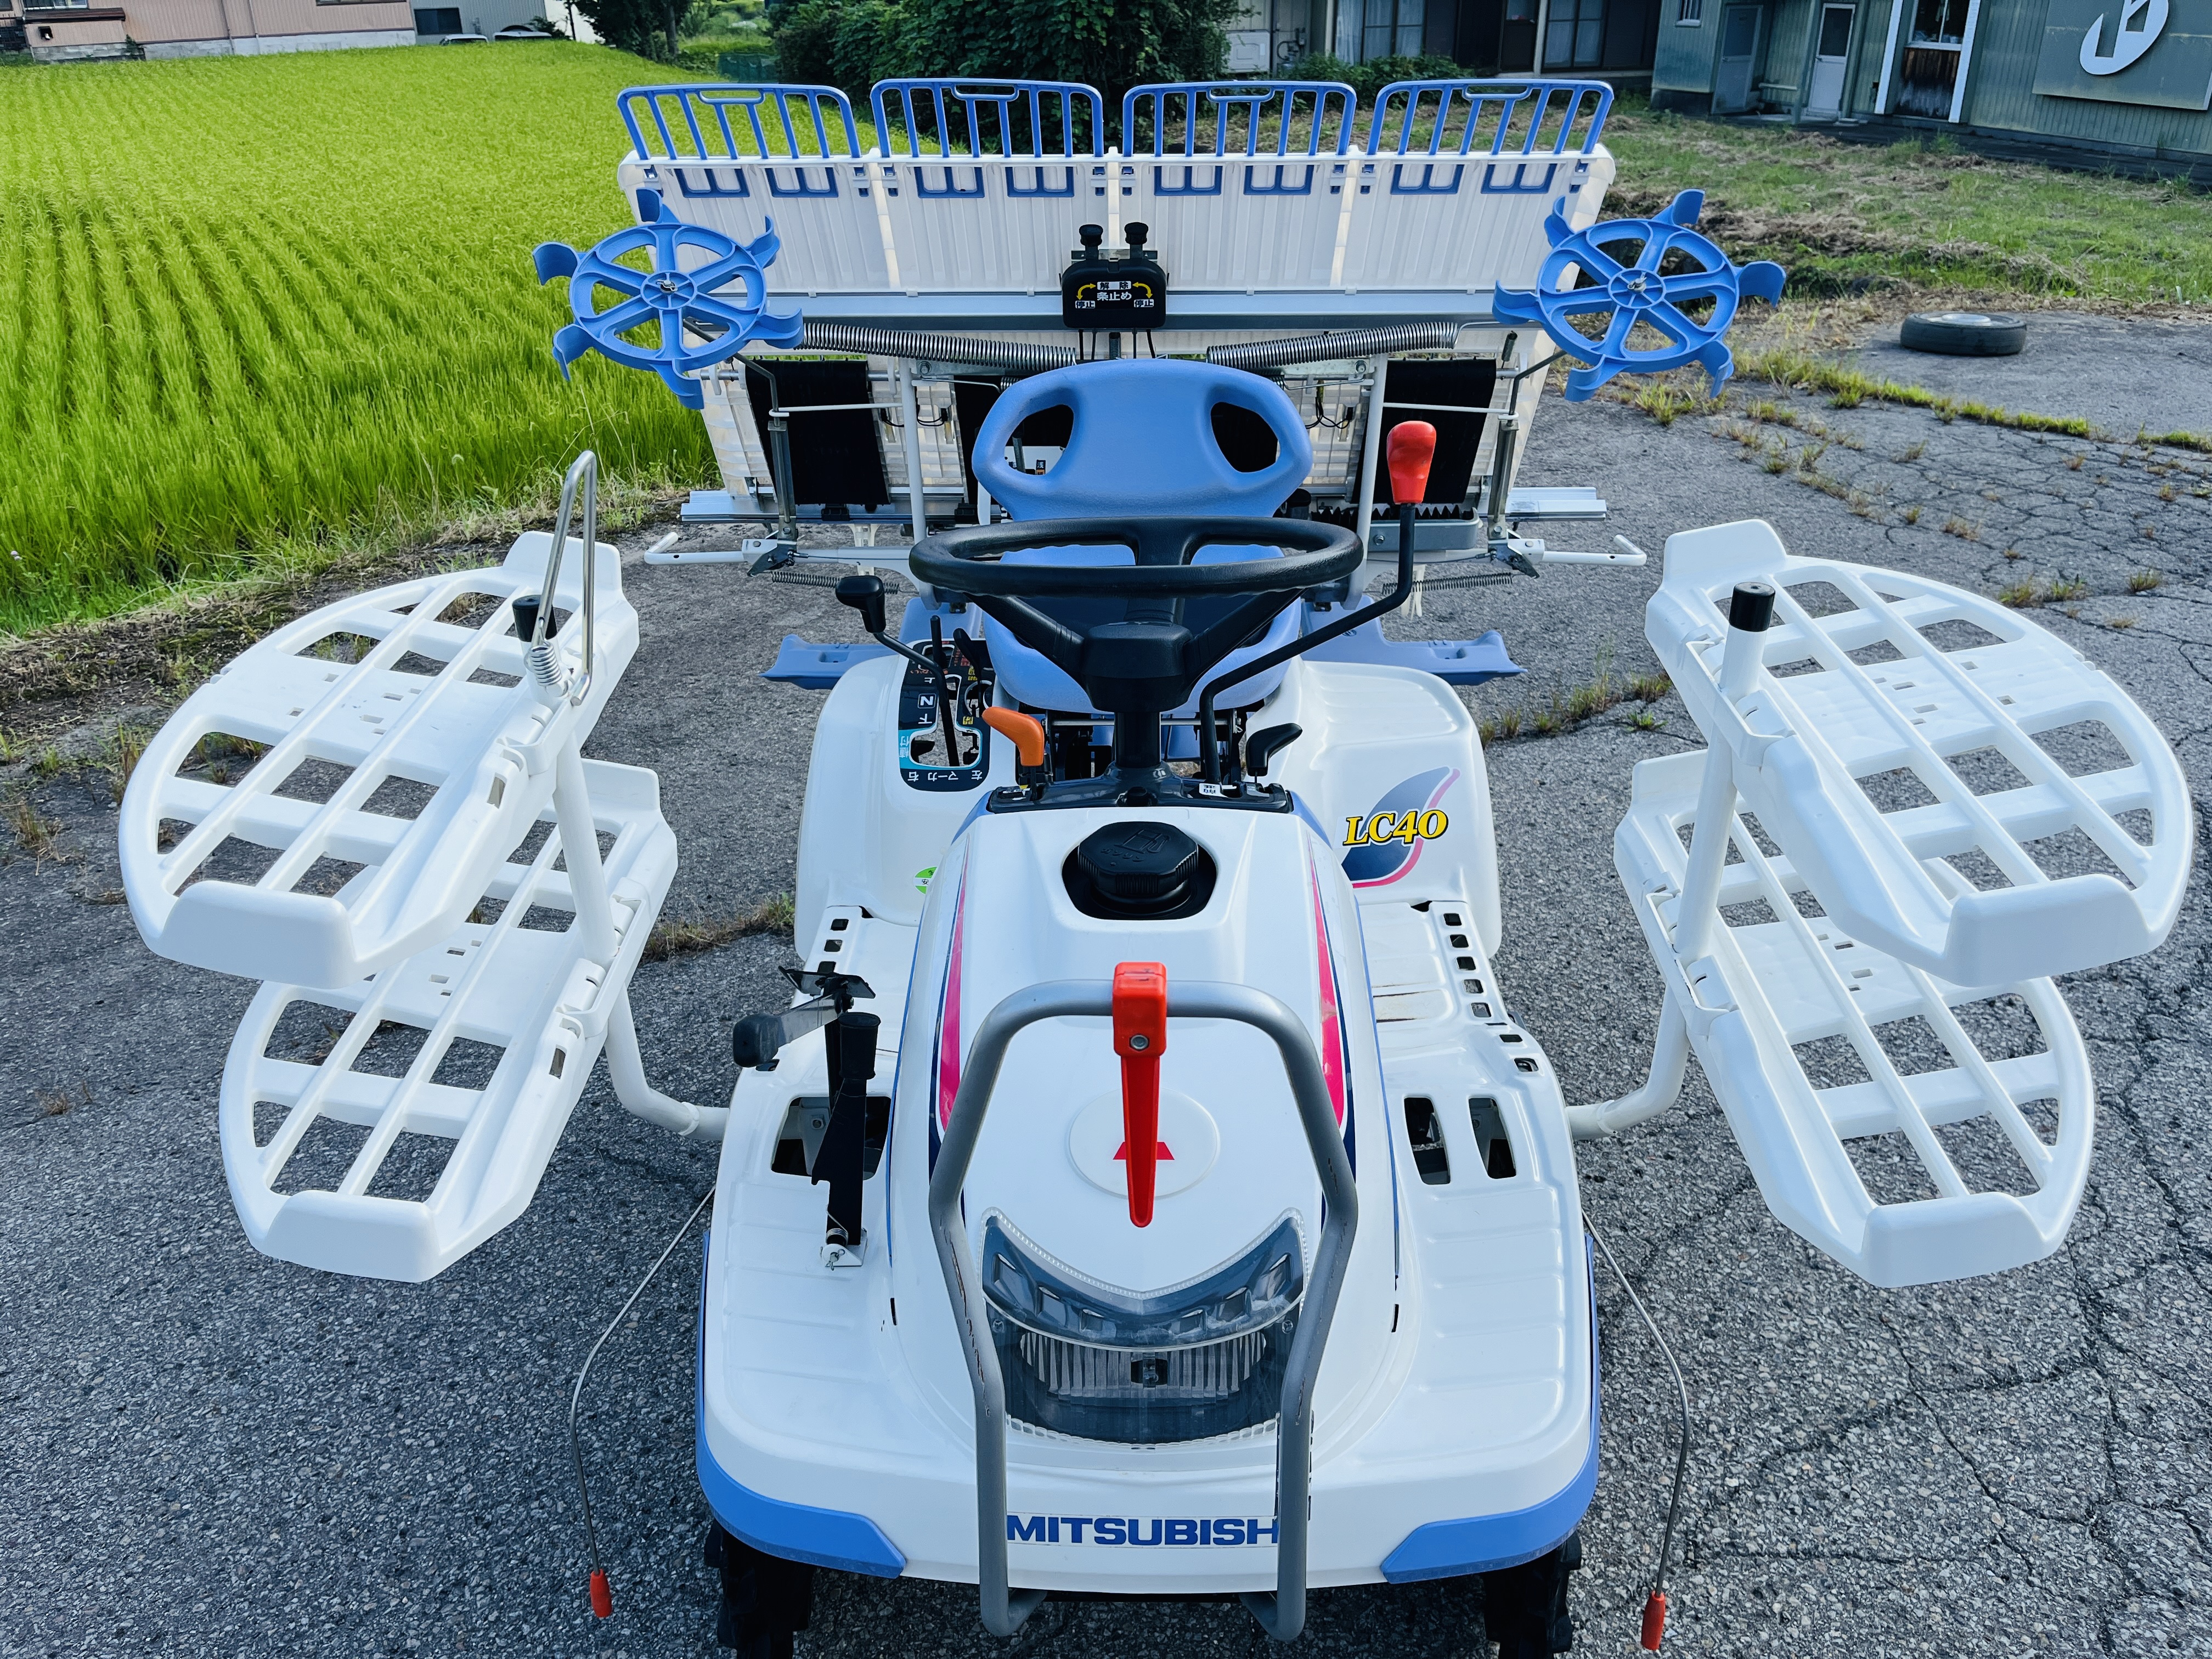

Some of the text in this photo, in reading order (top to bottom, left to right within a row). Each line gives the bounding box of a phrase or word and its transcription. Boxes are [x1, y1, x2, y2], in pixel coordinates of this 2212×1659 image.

[1097, 292, 1132, 301] 条止め
[1135, 300, 1154, 308] 停止
[920, 695, 934, 706] N
[918, 713, 933, 724] 下
[907, 770, 983, 782] 左 マーカ 右
[1342, 809, 1449, 846] LC40
[1007, 1515, 1278, 1545] MITSUBISH
